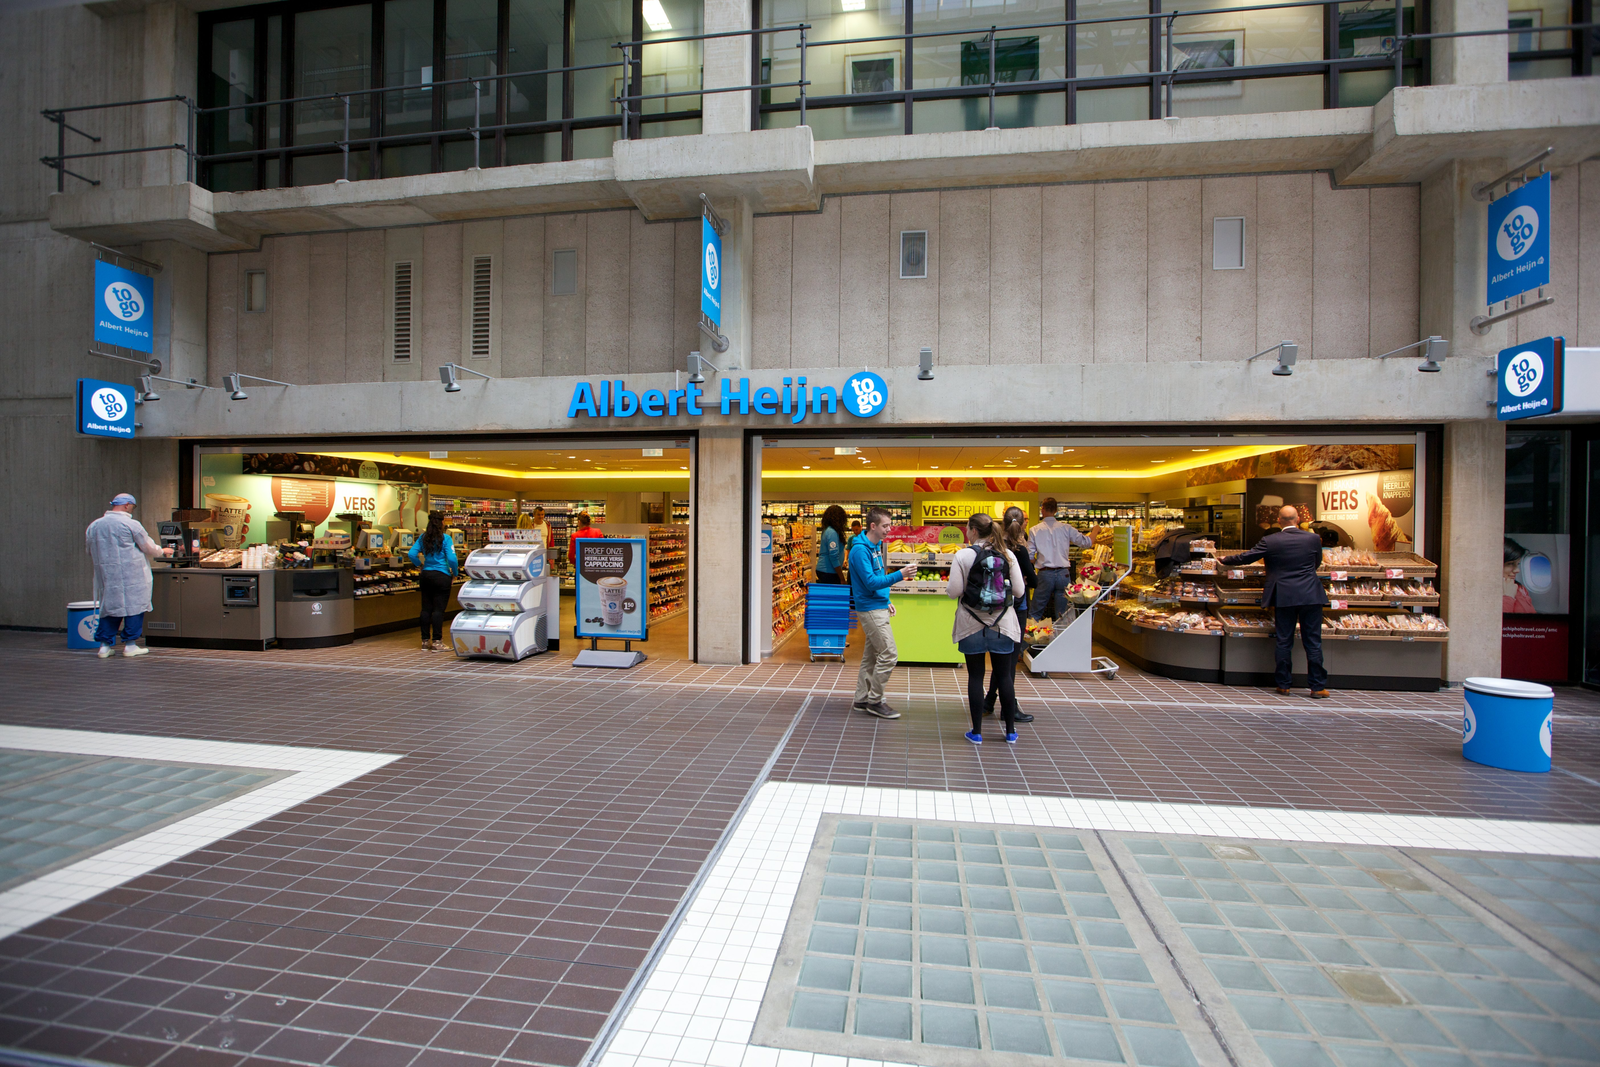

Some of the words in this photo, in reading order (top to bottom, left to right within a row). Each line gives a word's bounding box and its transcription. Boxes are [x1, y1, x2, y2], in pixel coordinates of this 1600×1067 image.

[1504, 214, 1524, 238] to
[1510, 223, 1534, 256] go
[1492, 269, 1514, 284] Albert
[1516, 260, 1536, 274] Heijn
[112, 287, 132, 302] to
[119, 300, 140, 318] go
[100, 320, 123, 332] Albert
[124, 326, 142, 337] Heijn
[1512, 359, 1529, 376] to
[851, 378, 874, 394] to
[1518, 368, 1537, 392] go
[99, 393, 116, 405] to
[567, 380, 702, 418] Albert
[720, 376, 837, 424] Heijn
[856, 390, 882, 414] go
[1500, 404, 1521, 414] Albert
[1522, 400, 1541, 410] Heijn
[105, 402, 123, 418] go
[109, 425, 126, 433] Heijn
[1321, 480, 1332, 491] WIJ
[1334, 479, 1359, 489] BAKKEN
[1383, 481, 1410, 490] HEERLIJK
[1322, 490, 1358, 510] VERS
[1383, 490, 1410, 499] KNAPPERIG
[344, 496, 375, 511] VERS
